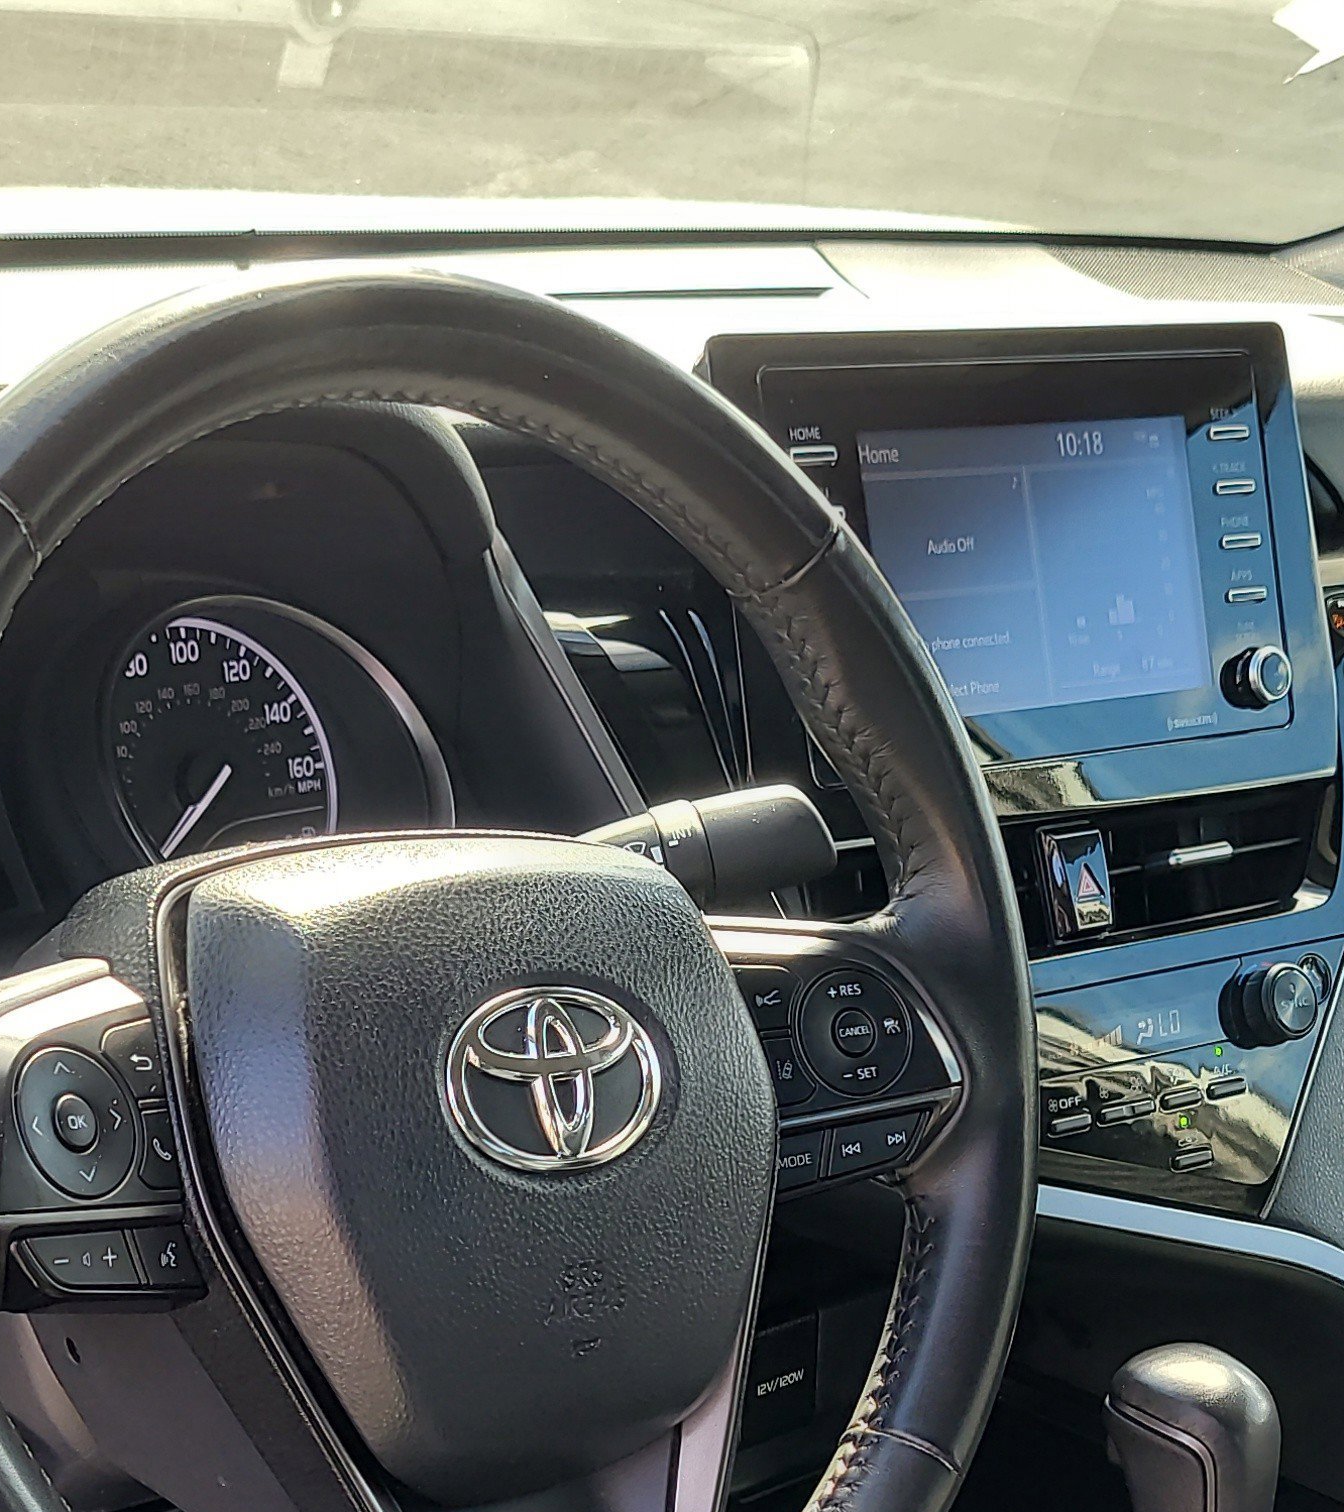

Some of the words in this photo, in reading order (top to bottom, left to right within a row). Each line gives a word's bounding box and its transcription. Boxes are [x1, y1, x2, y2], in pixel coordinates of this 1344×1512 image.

[789, 426, 821, 441] HOME
[1057, 431, 1104, 457] 10:18
[858, 445, 900, 464] Home
[1221, 516, 1249, 527] PHONE
[927, 539, 956, 555] Audio
[957, 537, 974, 551] Off
[932, 636, 960, 653] phone
[962, 631, 1010, 648] connected
[169, 640, 199, 664] 100
[223, 659, 250, 683] 120
[970, 680, 1000, 695] Phone
[264, 701, 291, 725] 140
[119, 720, 137, 734] 100
[288, 756, 315, 779] 160
[297, 778, 322, 793] MPH
[672, 827, 693, 841] INT
[839, 983, 862, 997] RES
[838, 1024, 872, 1039] CANCEL
[857, 1066, 878, 1080] SET
[1059, 1095, 1082, 1109] OFF
[67, 1114, 90, 1130] OK
[777, 1152, 813, 1170] MODE
[757, 1368, 805, 1397] 12V/120W
